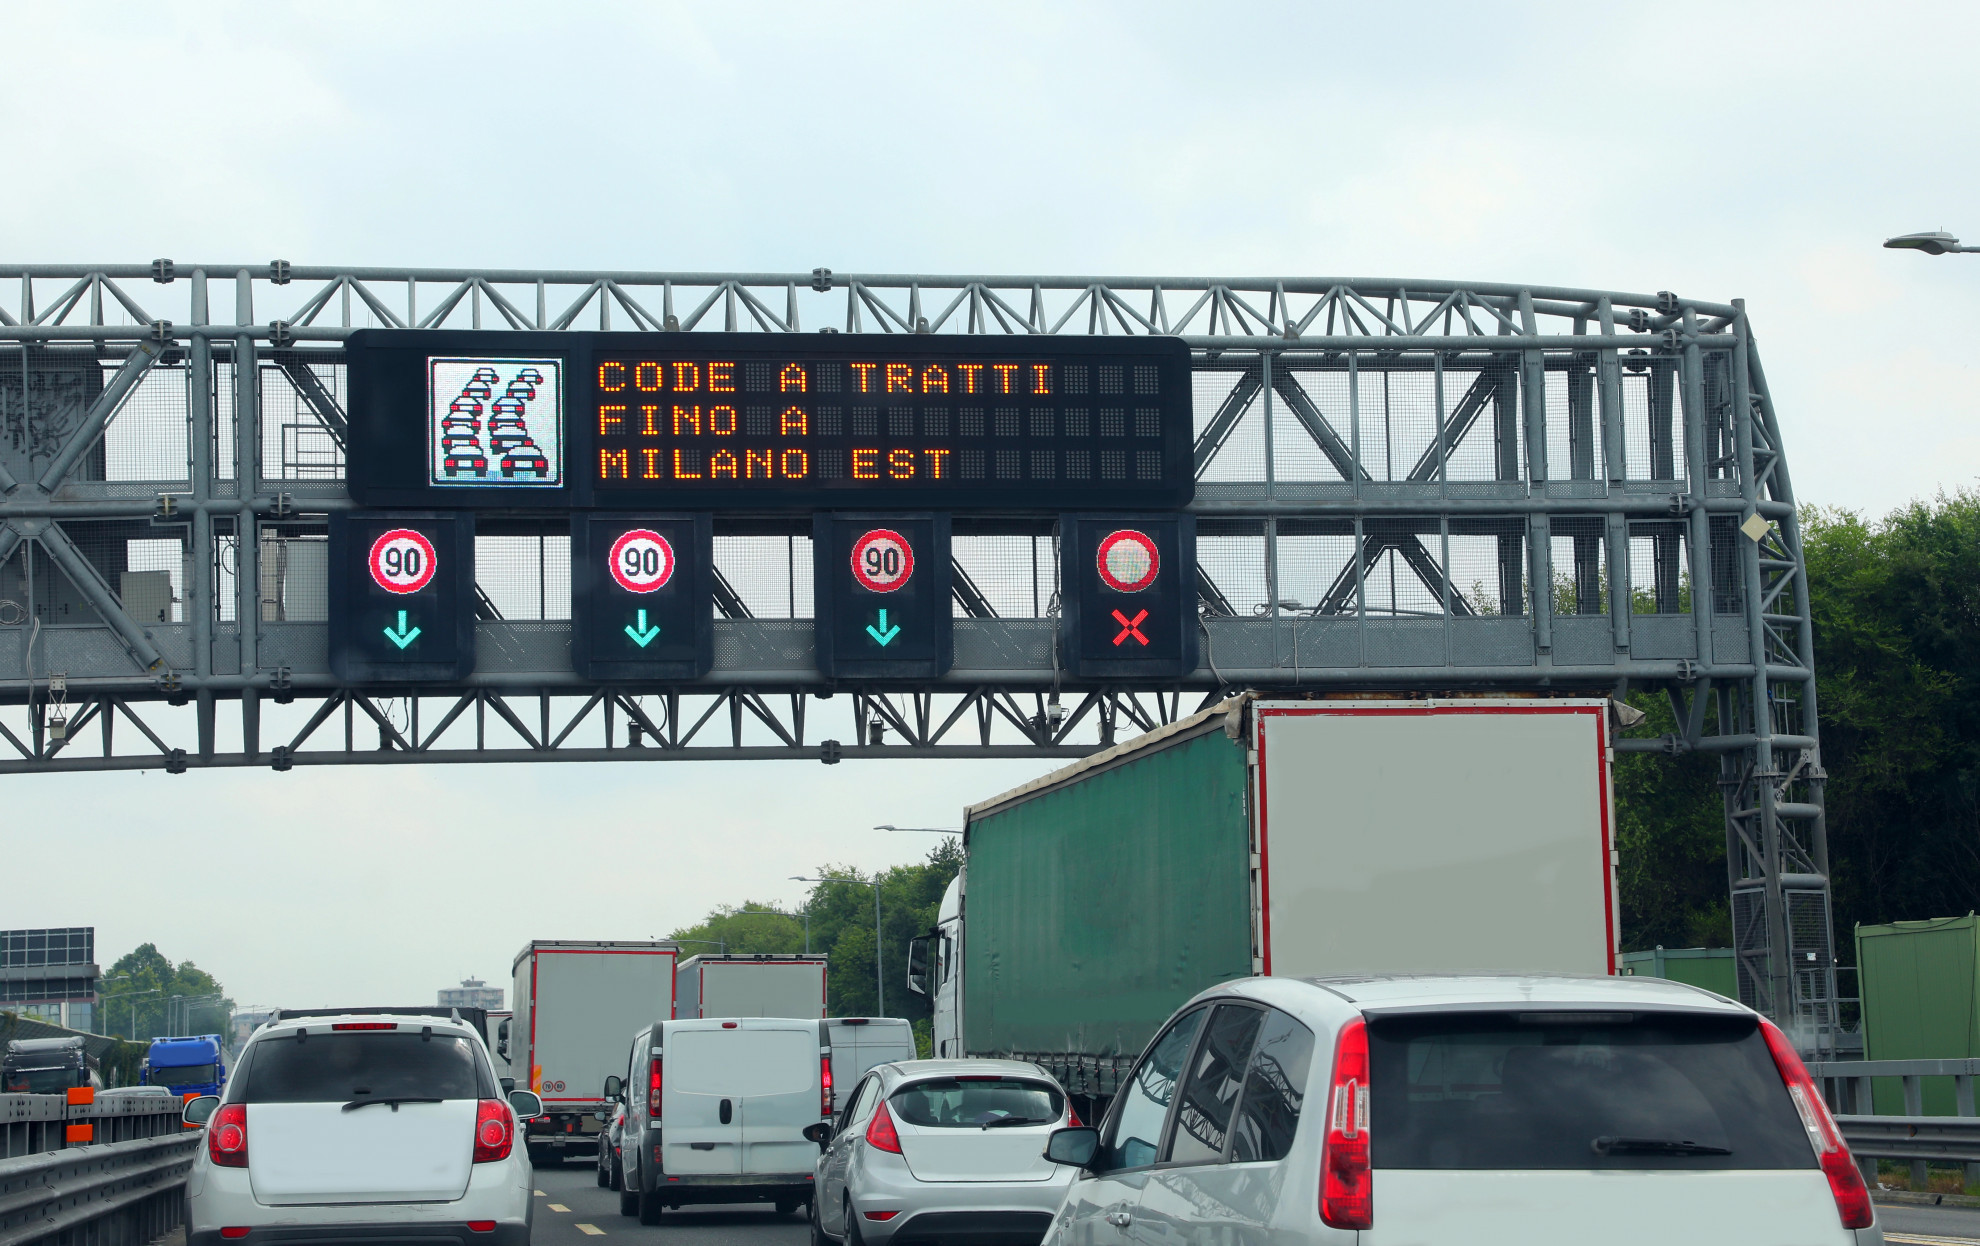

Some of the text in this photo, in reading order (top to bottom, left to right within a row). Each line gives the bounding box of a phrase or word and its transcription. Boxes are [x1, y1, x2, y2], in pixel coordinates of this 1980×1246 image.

[598, 361, 1050, 394] CODE A TRATTI
[598, 405, 807, 436] FINO A
[599, 448, 950, 480] MILANO EST
[386, 547, 421, 577] 90
[625, 547, 659, 577] 90
[866, 547, 899, 577] 90
